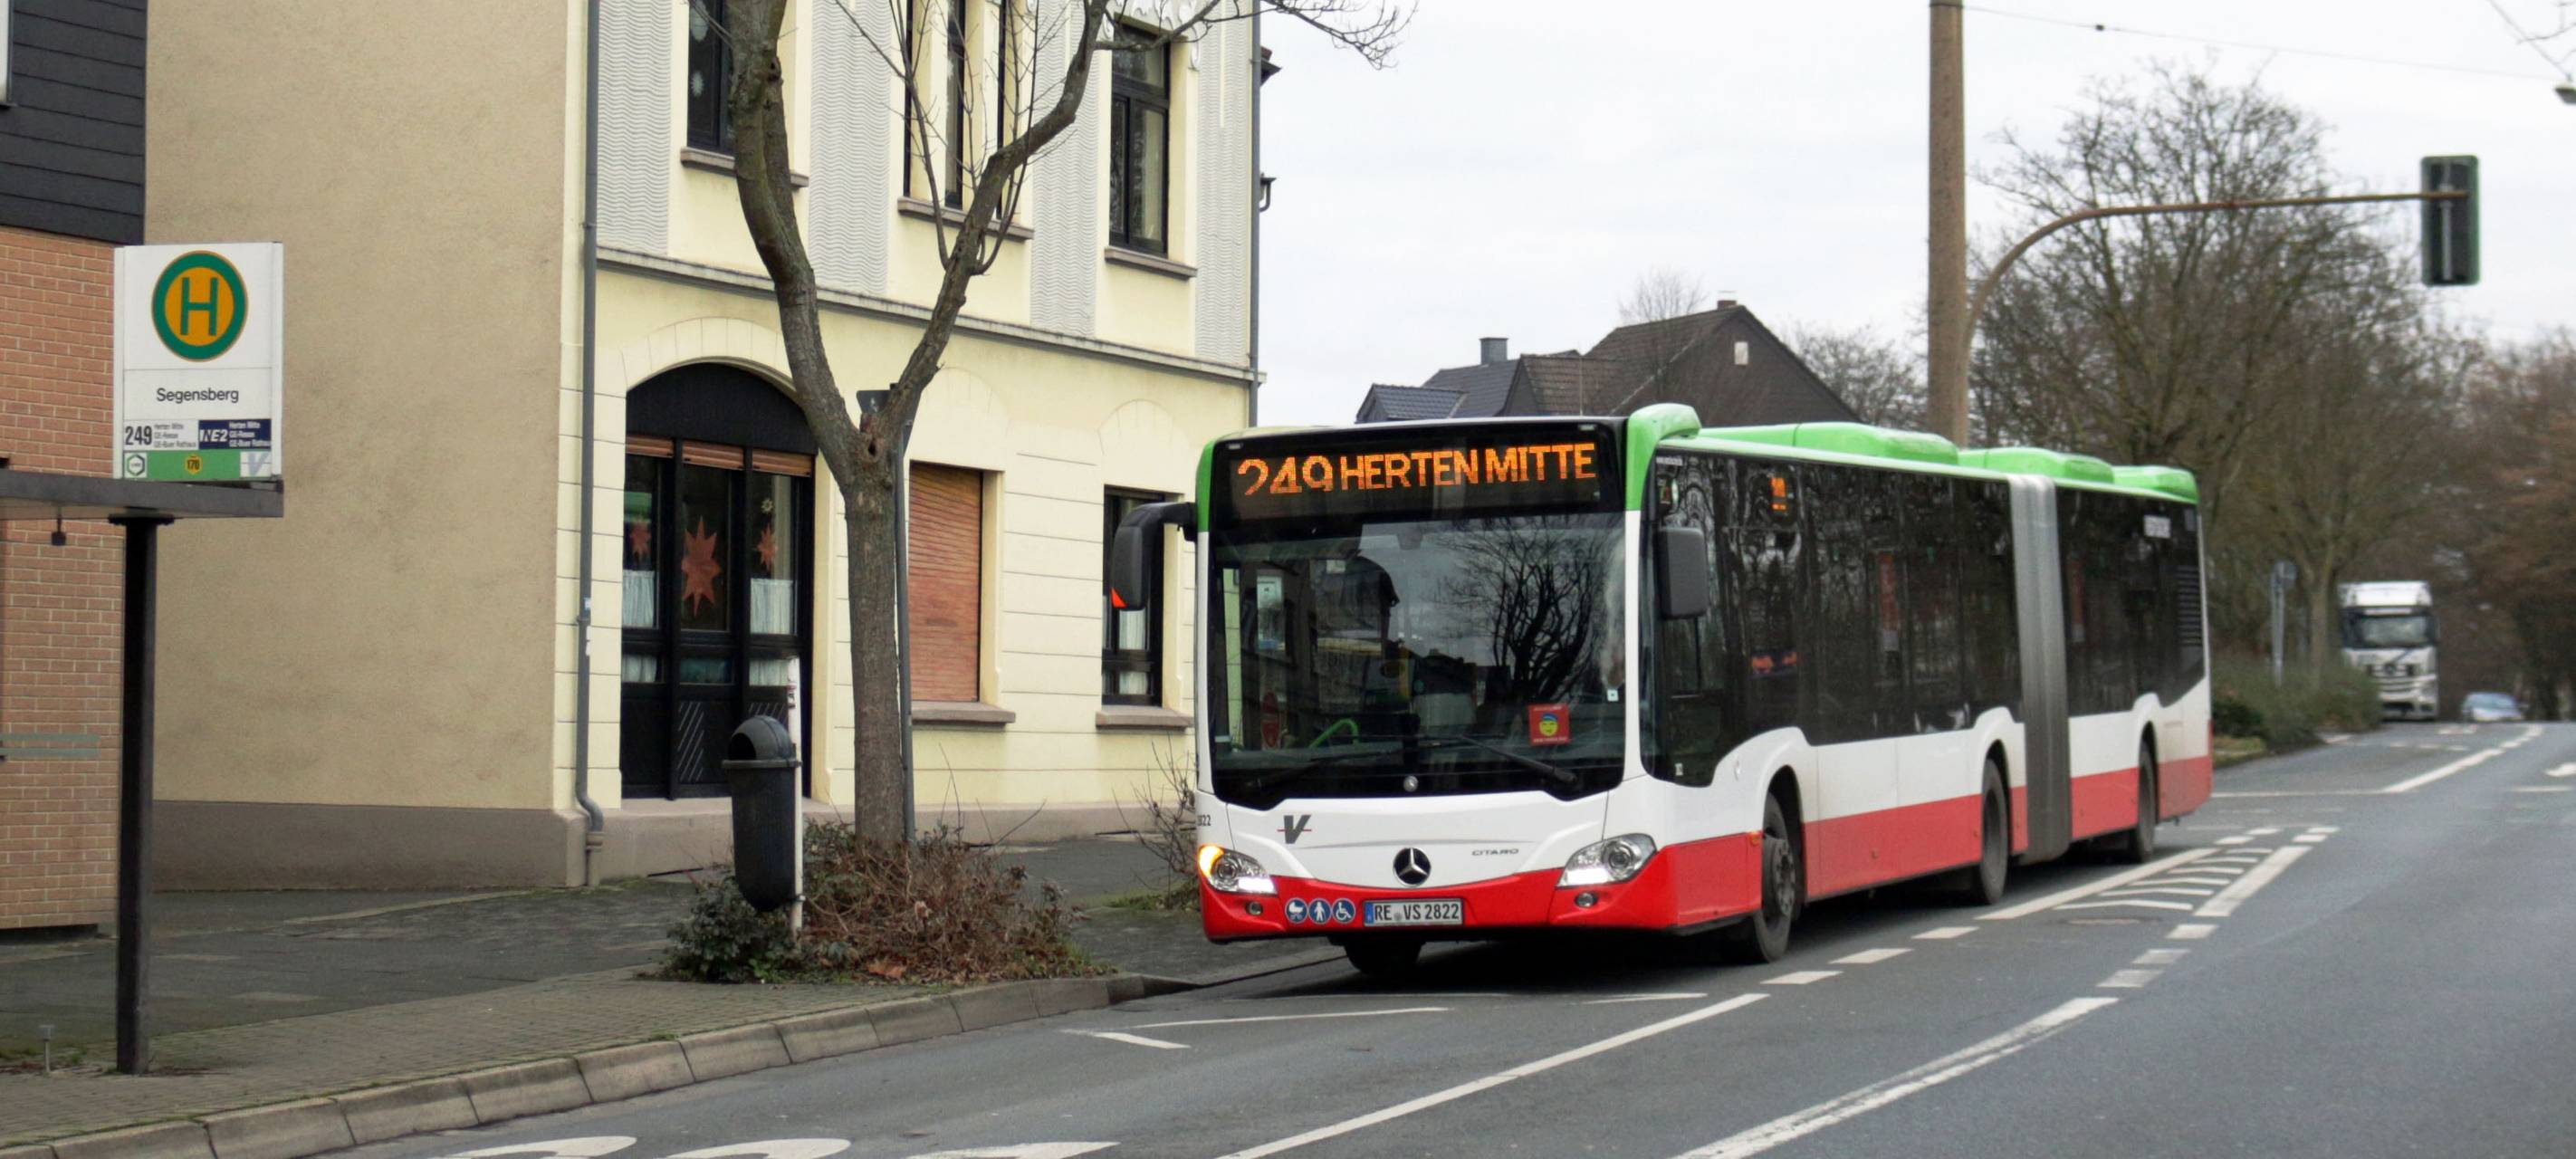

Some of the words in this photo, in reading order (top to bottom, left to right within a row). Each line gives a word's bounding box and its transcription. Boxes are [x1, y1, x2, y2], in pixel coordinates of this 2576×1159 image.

[180, 276, 218, 336] H
[156, 387, 240, 405] Segensberg
[125, 425, 152, 445] 249
[1237, 455, 1335, 496] 249
[1340, 449, 1479, 491] HERTEN
[1485, 443, 1597, 484] MITTE
[1472, 848, 1520, 857] CITARO
[1374, 904, 1393, 921] RE
[1403, 904, 1422, 920] VS
[1424, 903, 1460, 920] 2822
